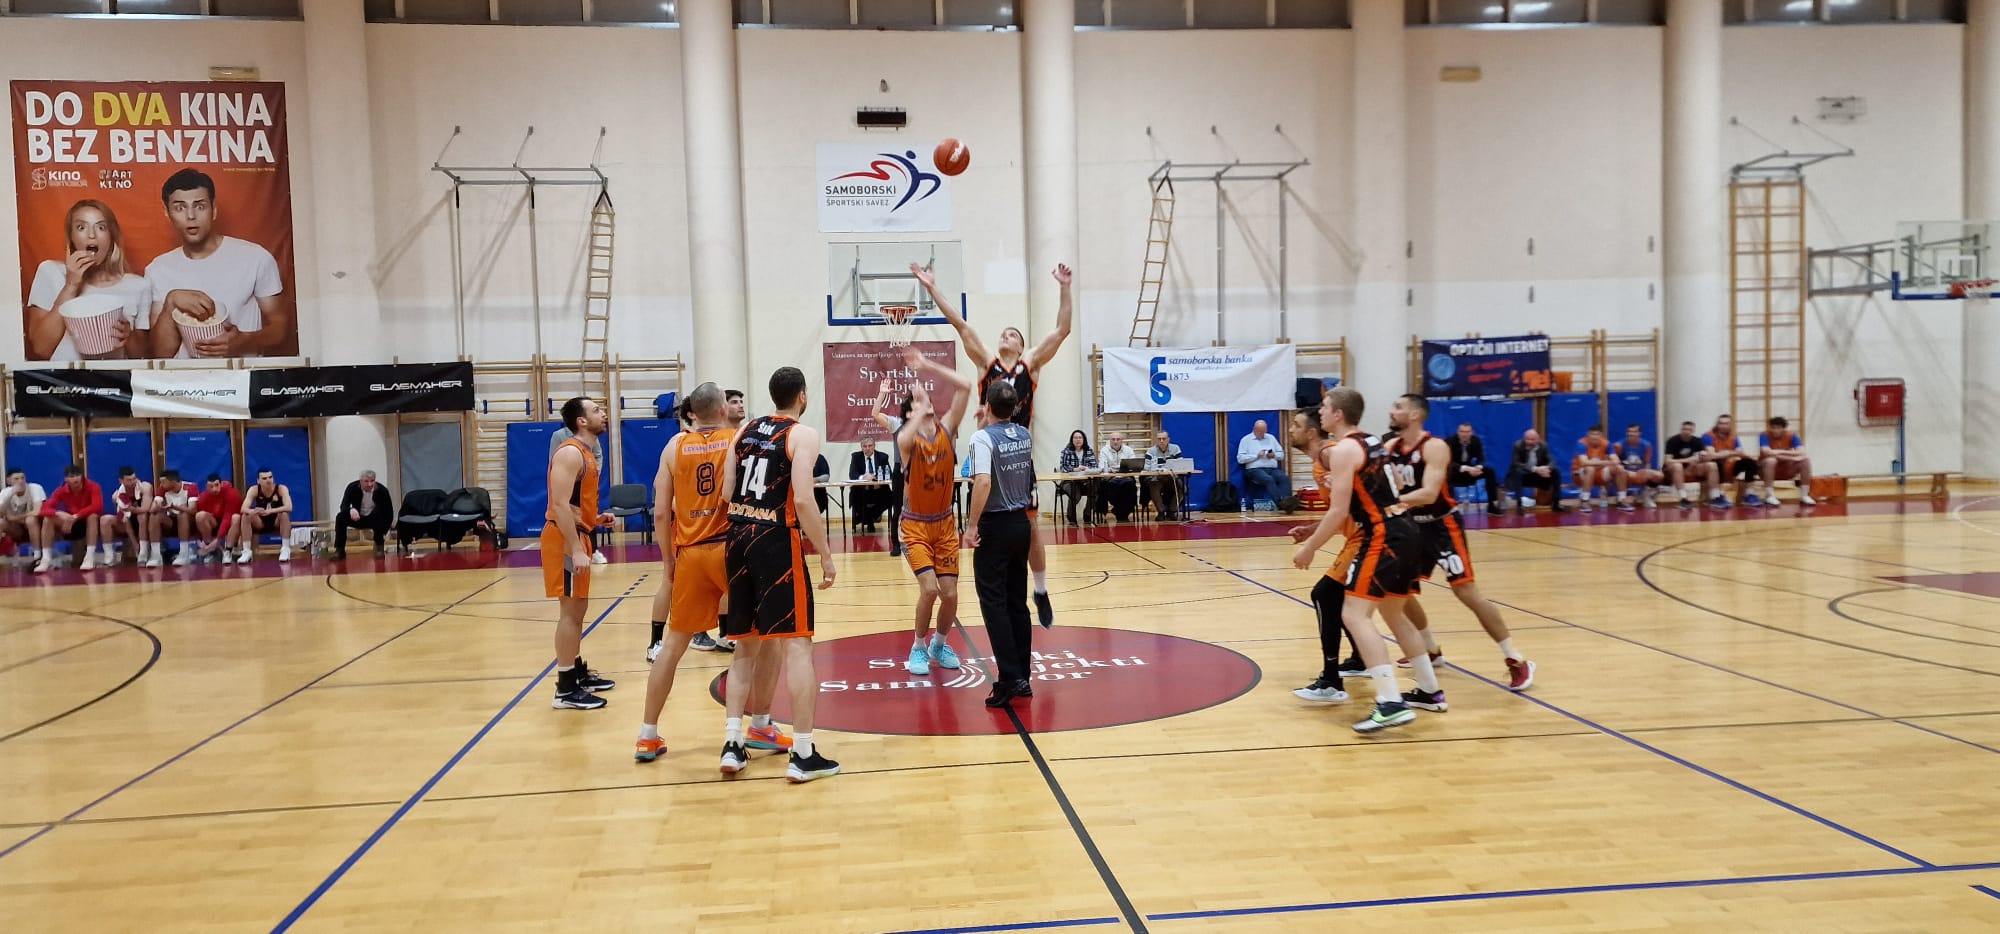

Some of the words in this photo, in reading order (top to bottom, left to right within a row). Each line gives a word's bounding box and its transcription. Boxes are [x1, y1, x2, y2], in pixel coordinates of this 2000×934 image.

[25, 91, 83, 126] DO
[94, 92, 171, 126] DVA
[180, 92, 272, 126] KINA
[27, 130, 98, 163] BEZ
[109, 129, 275, 163] BENZINA
[48, 171, 81, 181] KINO
[825, 185, 897, 195] SAMOBORSKI
[826, 198, 864, 206] ŠPORTSKI
[1168, 356, 1222, 365] samoborska
[1224, 354, 1253, 364] banka
[1168, 372, 1190, 381] 1873
[26, 385, 121, 396] GLASMAHER
[260, 384, 345, 396] GLASMAHER
[370, 380, 463, 392] GLASMAHER
[144, 389, 237, 397] GLASMAHER
[697, 462, 716, 496] 8
[741, 455, 769, 500] 14
[942, 557, 957, 568] 24
